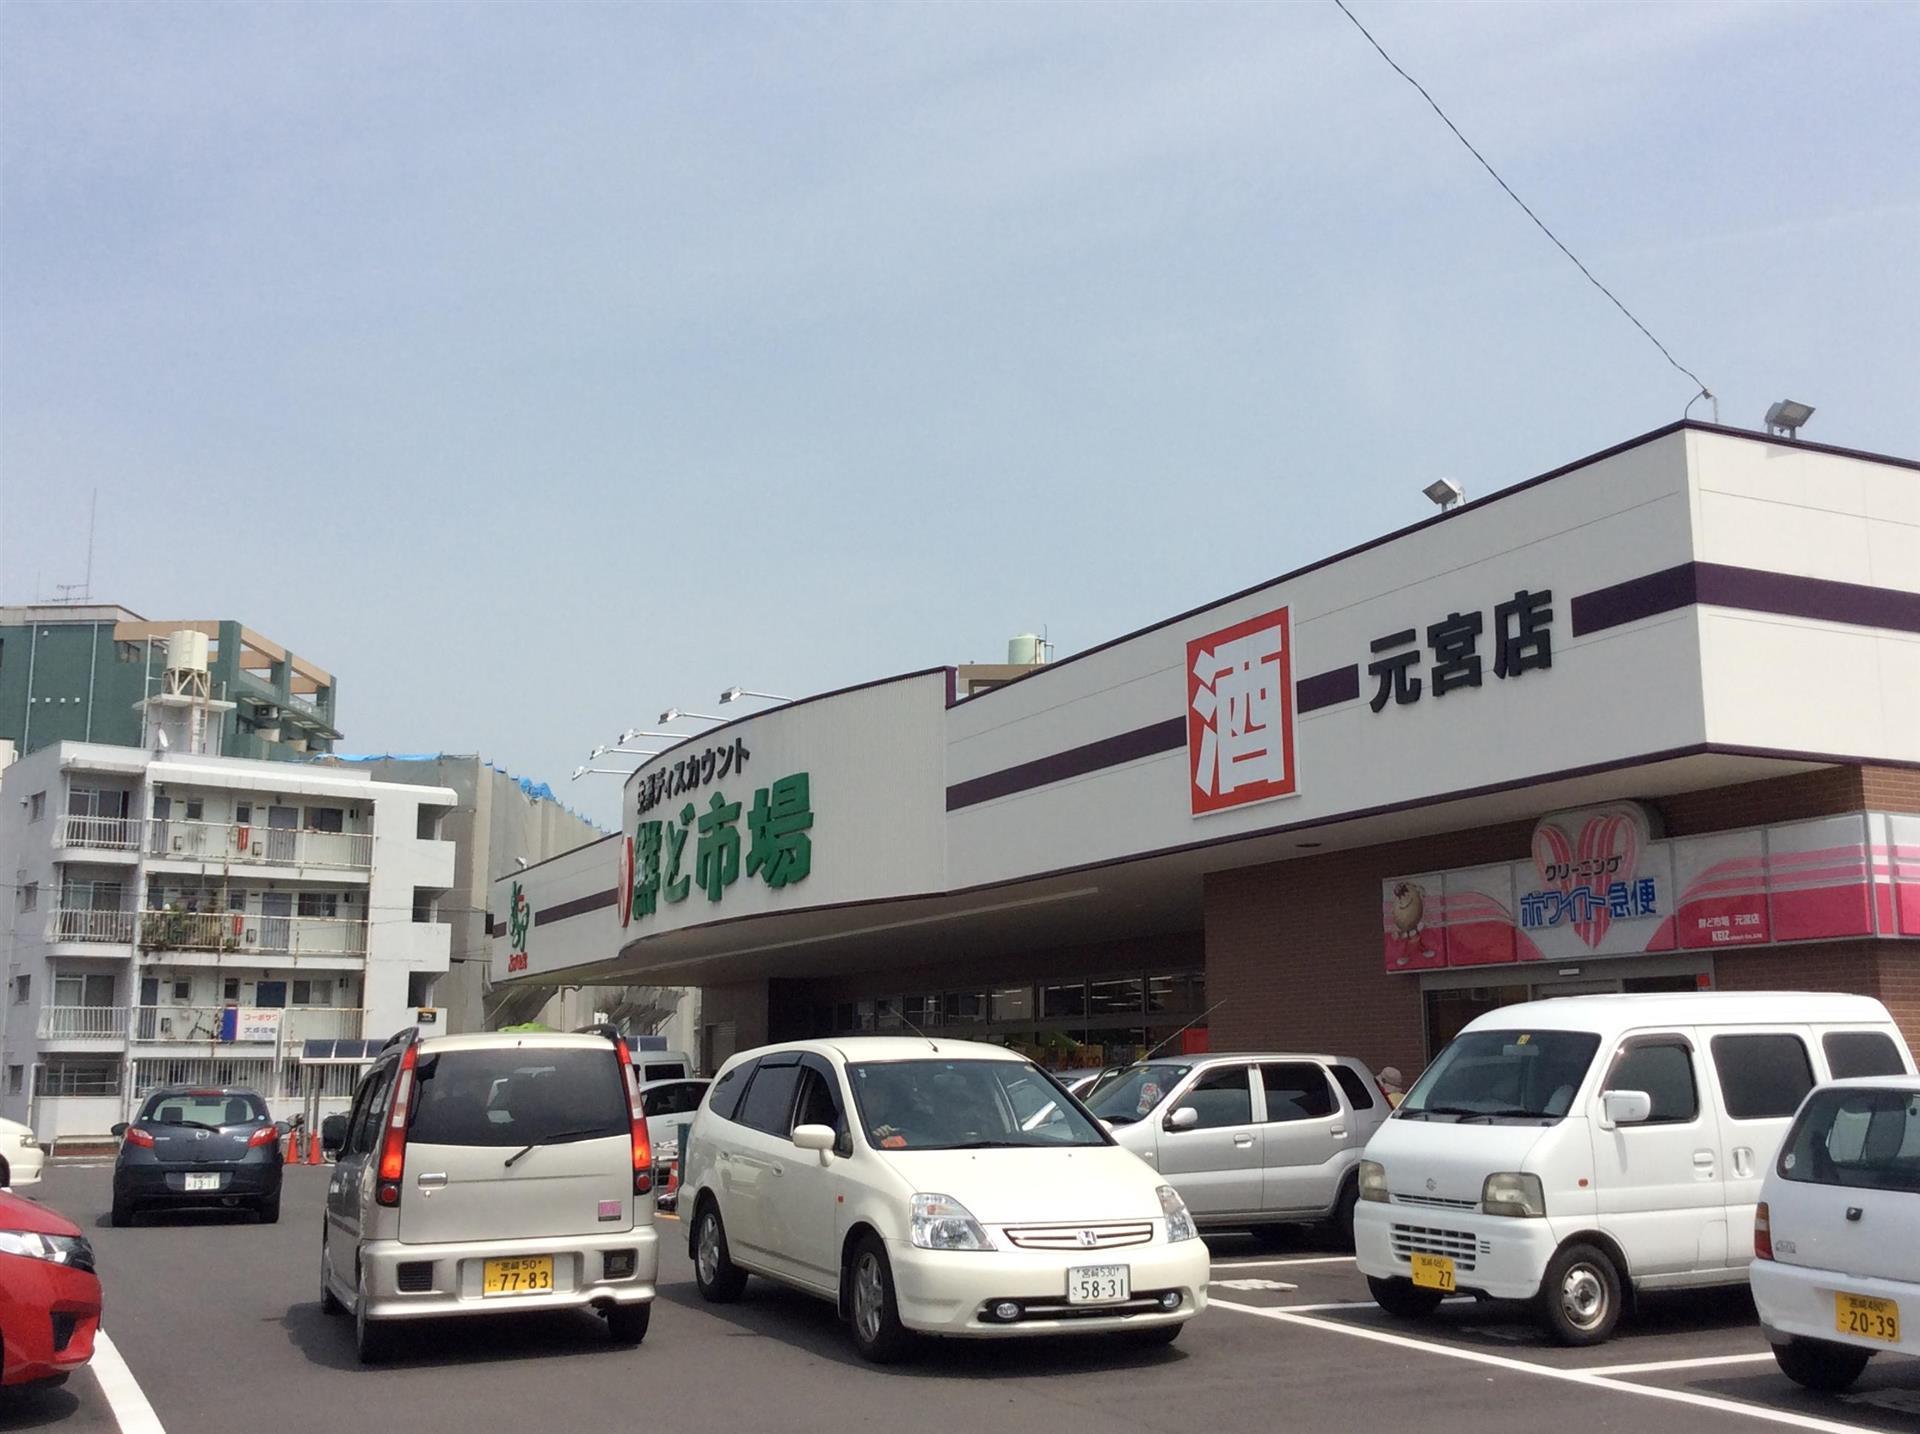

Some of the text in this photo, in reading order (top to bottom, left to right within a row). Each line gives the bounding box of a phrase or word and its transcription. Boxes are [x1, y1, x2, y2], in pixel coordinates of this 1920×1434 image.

[1367, 589, 1553, 713] 元宮店
[1192, 624, 1285, 798] 酒
[1545, 856, 1622, 881] クリーニング
[1520, 878, 1656, 927] ホワイト急便
[500, 1271, 549, 1291] 77-83
[1081, 1278, 1124, 1299] 58-31
[1849, 1310, 1897, 1338] 20-39
